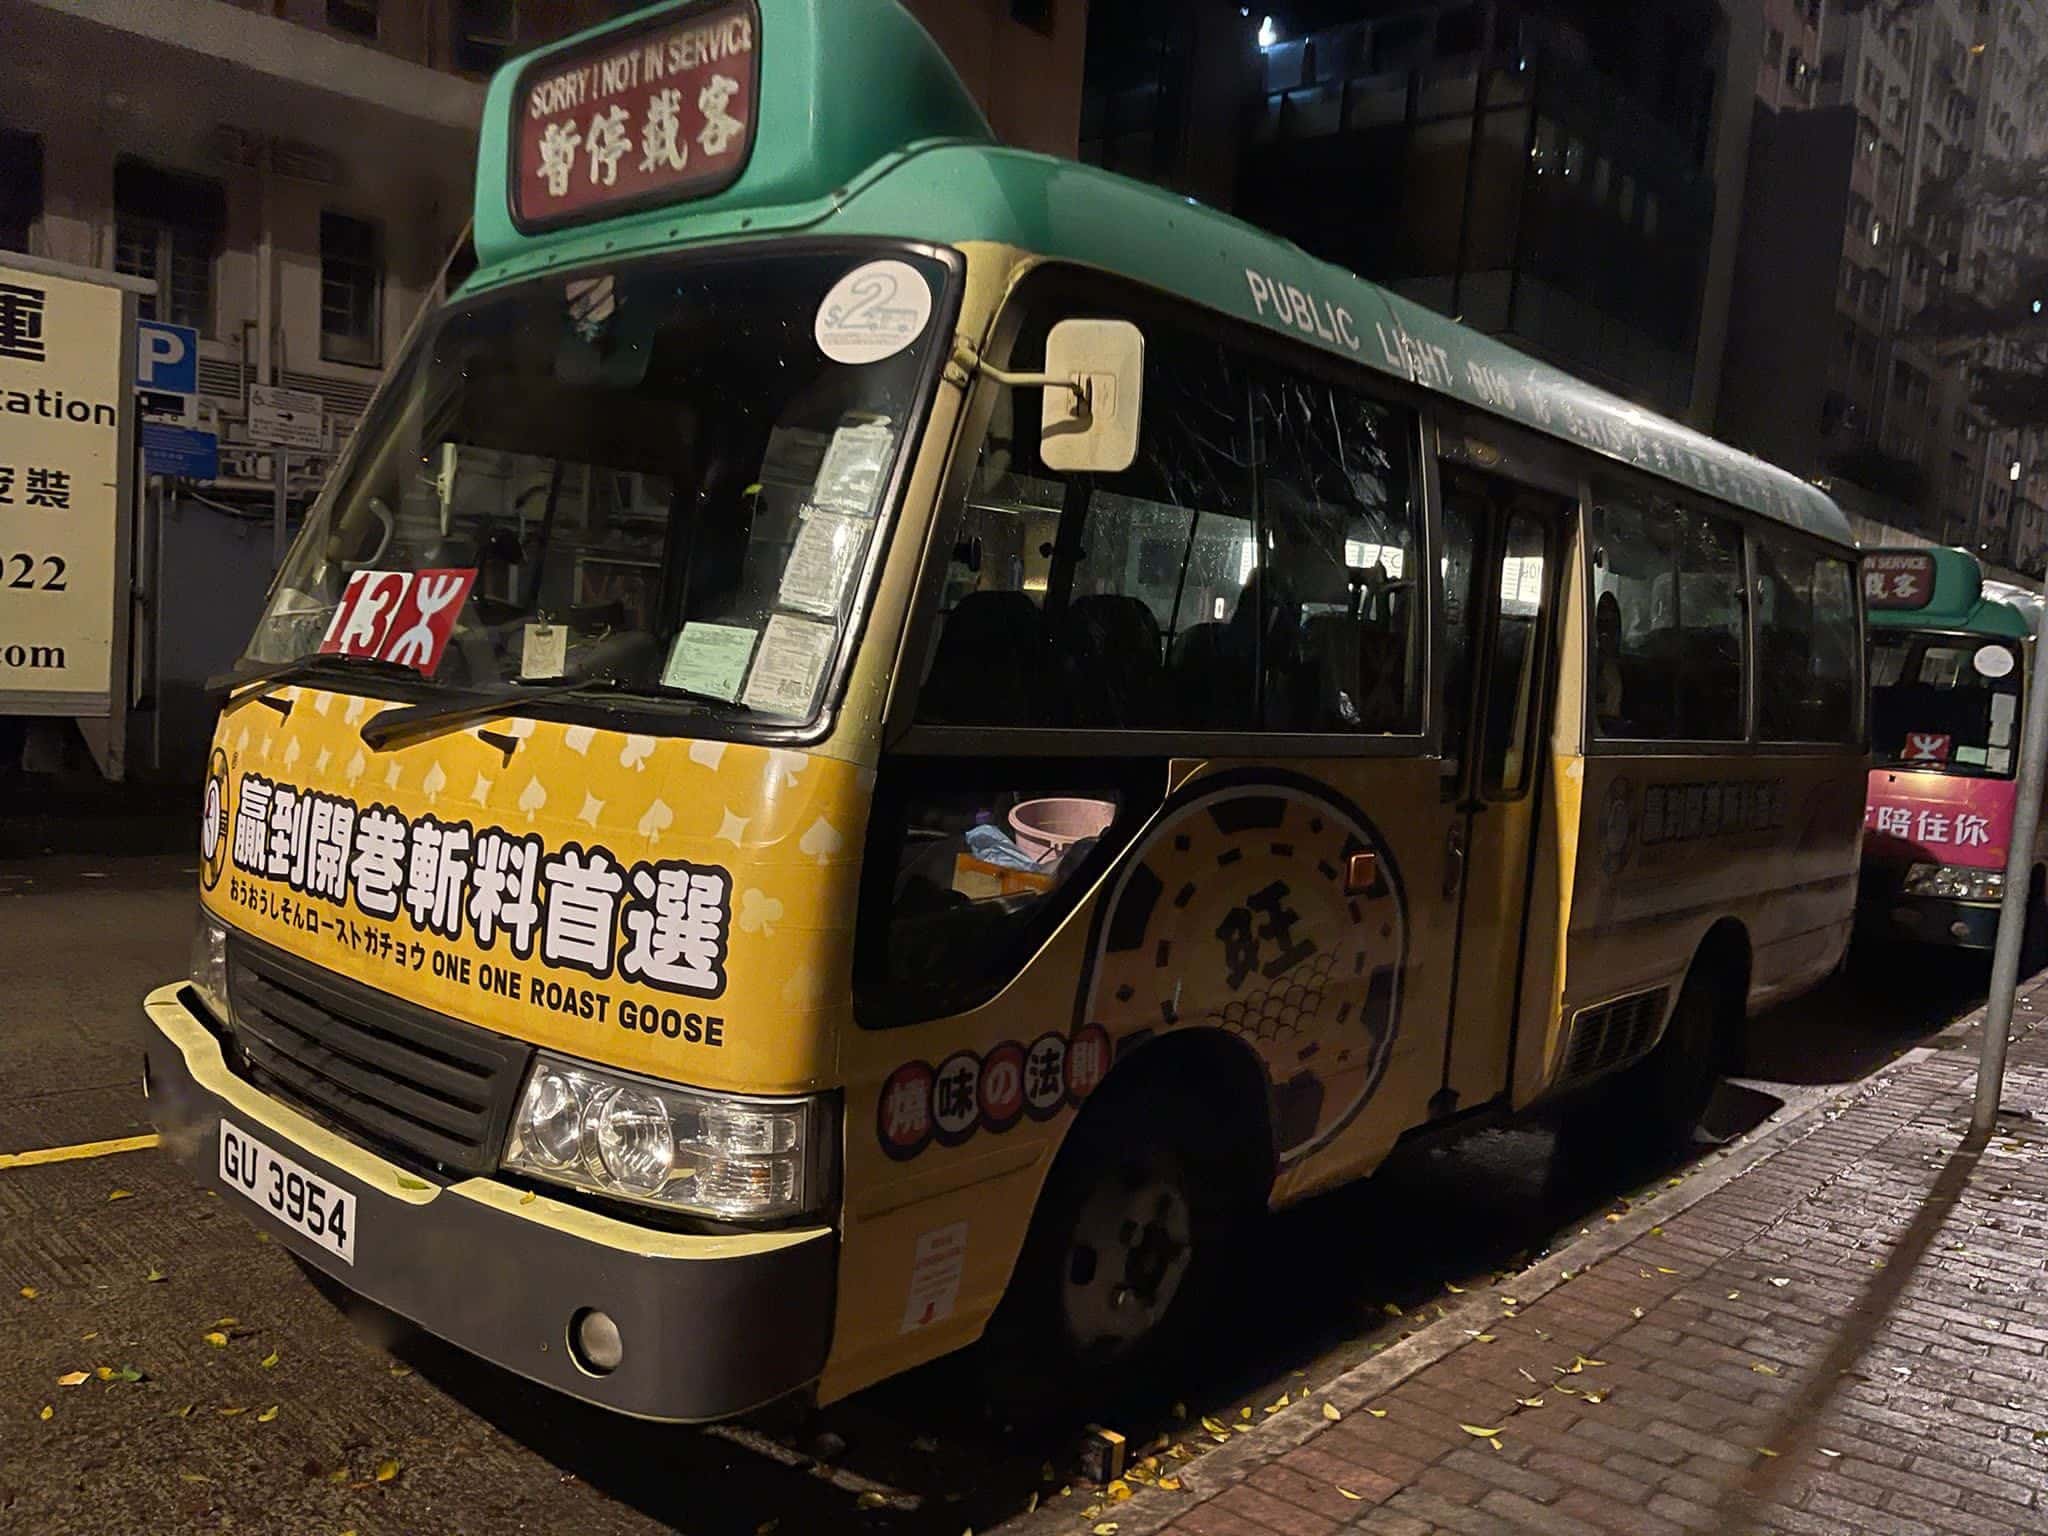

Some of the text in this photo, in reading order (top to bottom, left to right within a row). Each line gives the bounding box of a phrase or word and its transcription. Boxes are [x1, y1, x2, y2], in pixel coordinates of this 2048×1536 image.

[531, 69, 590, 120] SORRY
[602, 50, 641, 97] NOT
[644, 42, 664, 83] IN
[1245, 268, 1360, 351] PUBLIC
[138, 328, 185, 382] P
[0, 388, 116, 427] ation
[0, 553, 67, 591] 22
[318, 573, 405, 658] 13
[0, 644, 66, 669] om
[1865, 805, 1990, 847] 陪住你
[432, 950, 471, 985] ONE
[479, 964, 521, 1000] ONE
[530, 978, 610, 1023] ROAST
[618, 1000, 724, 1047] GOOSE
[225, 1133, 346, 1249] GU 3954
